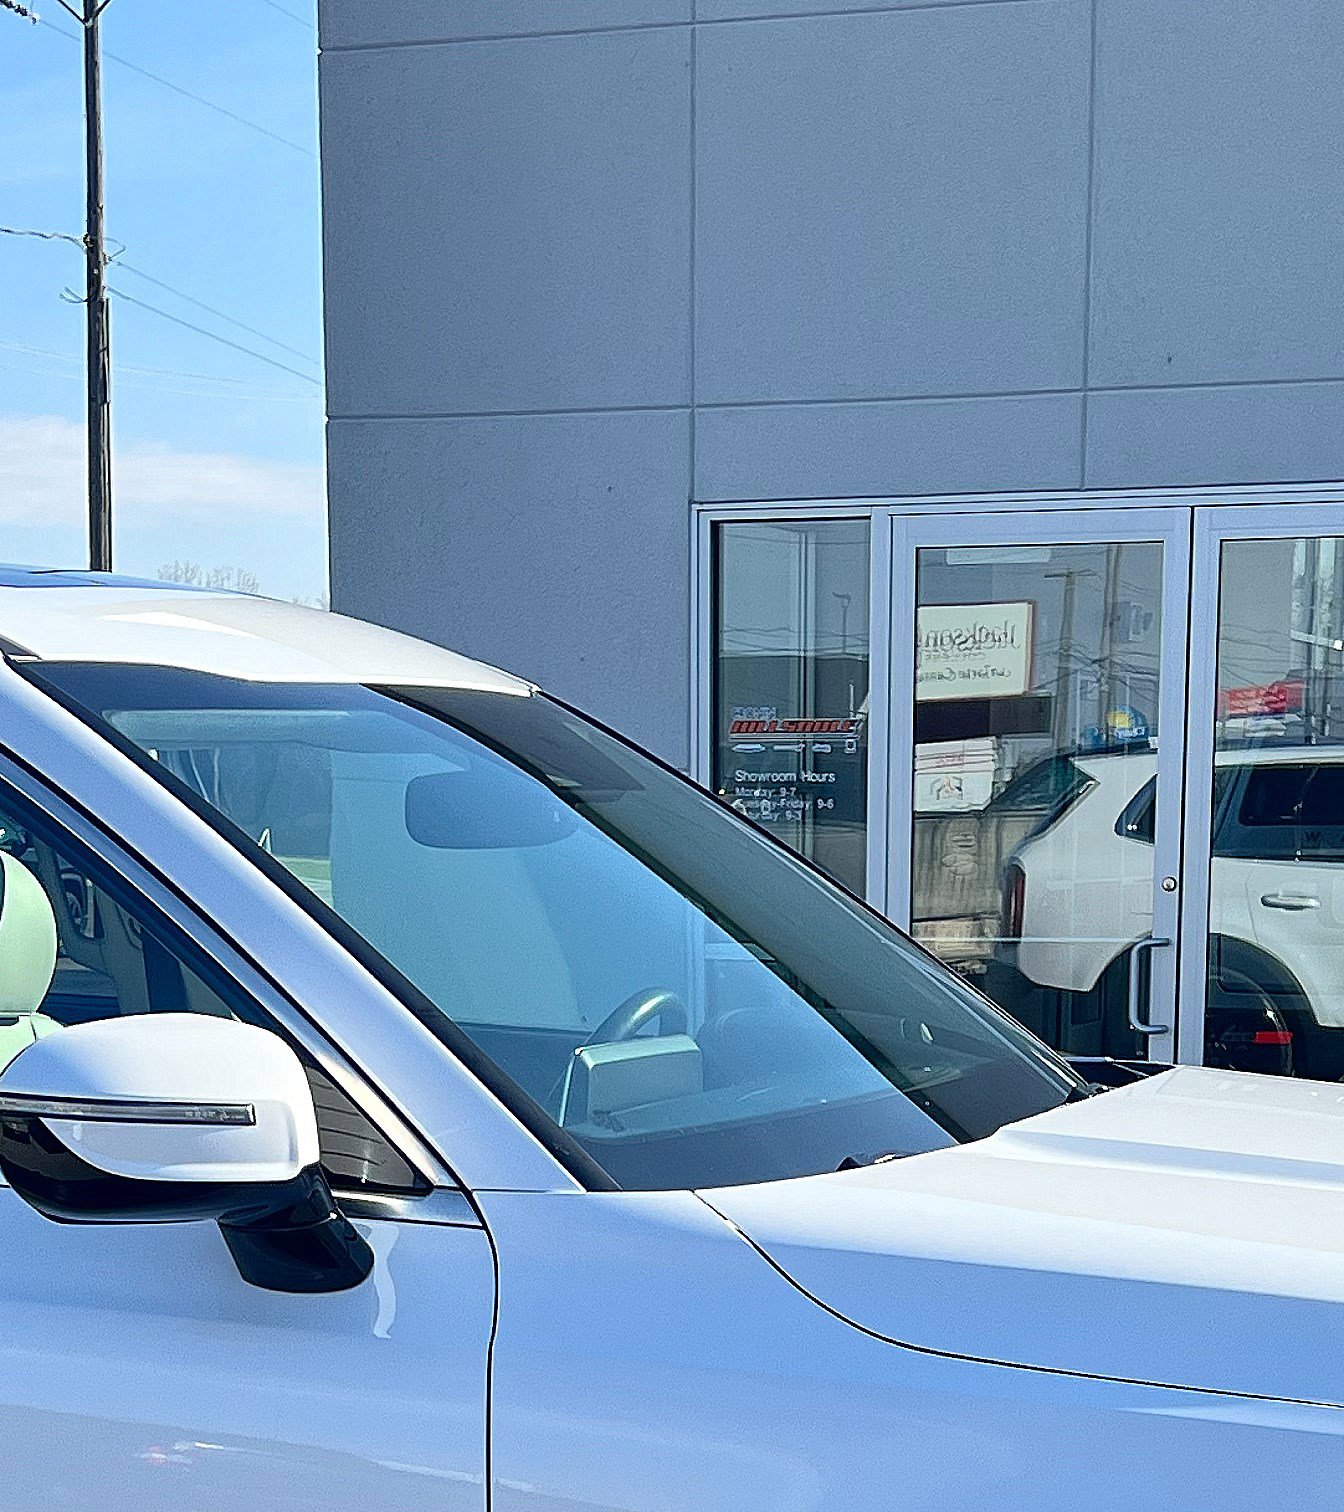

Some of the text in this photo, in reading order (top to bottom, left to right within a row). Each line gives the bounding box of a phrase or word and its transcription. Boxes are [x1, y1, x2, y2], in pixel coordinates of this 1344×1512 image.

[735, 769, 836, 782] Showroom Hours
[817, 798, 835, 810] 9-6
